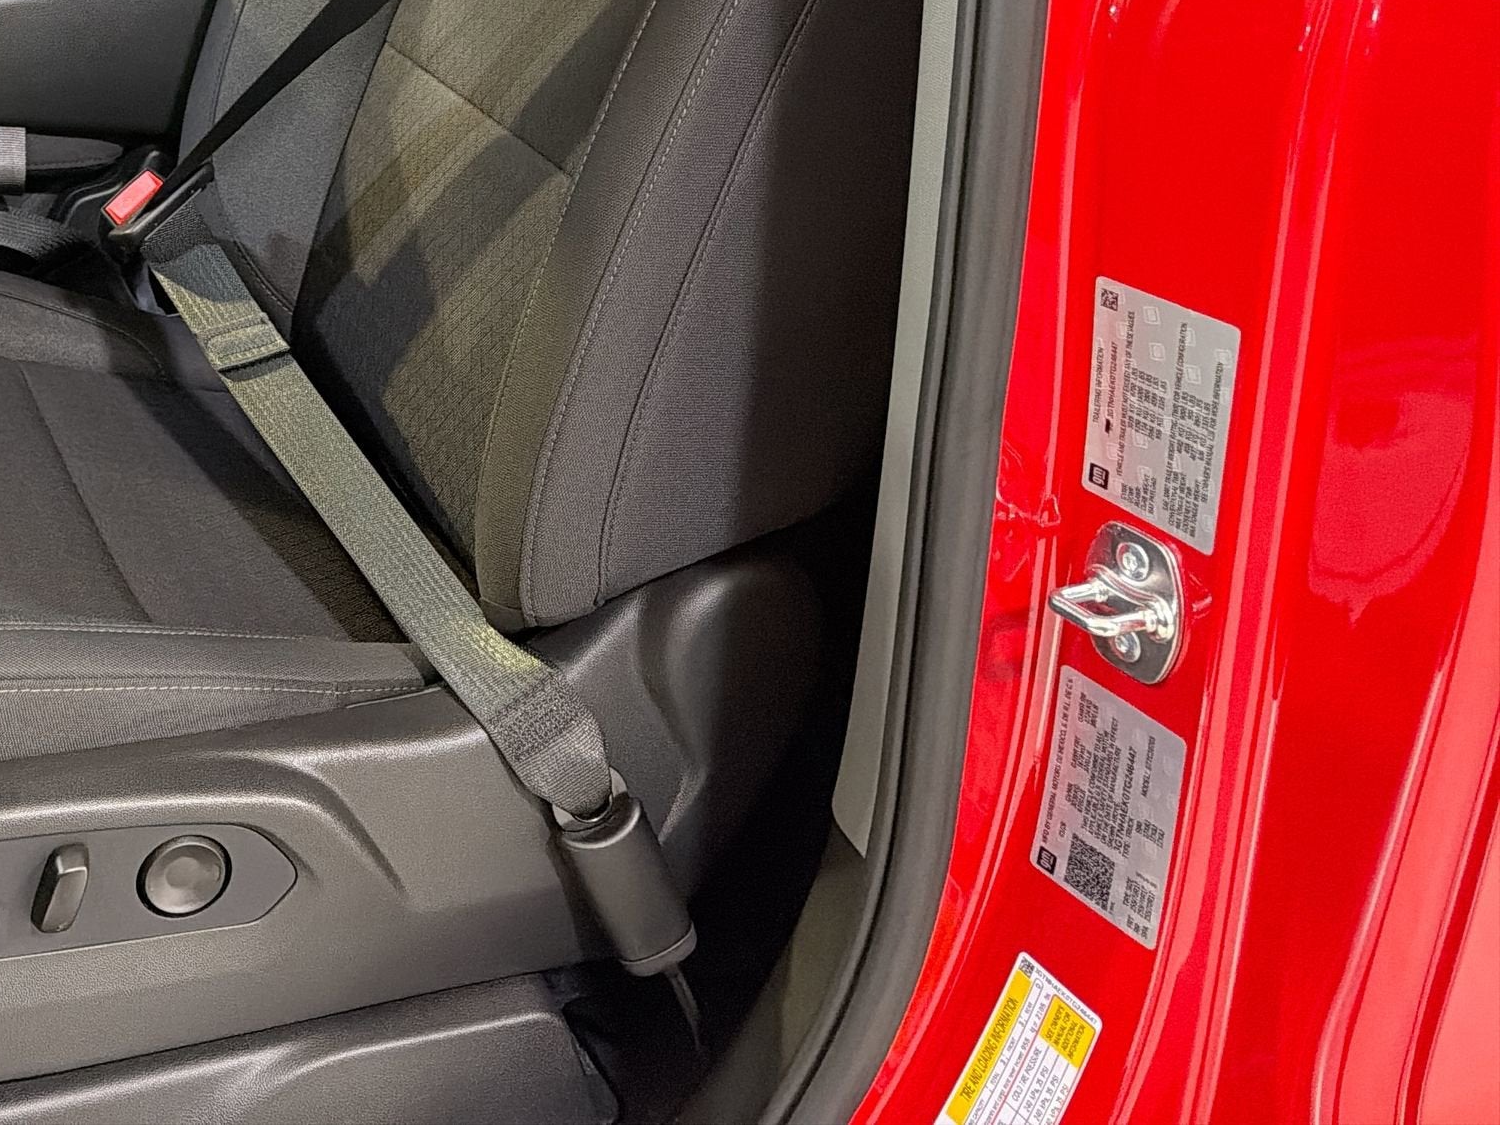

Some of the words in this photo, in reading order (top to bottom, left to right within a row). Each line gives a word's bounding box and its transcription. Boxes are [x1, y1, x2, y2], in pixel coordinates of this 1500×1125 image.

[1039, 848, 1054, 872] gm
[990, 995, 1019, 1043] INFORMATION
[975, 1038, 999, 1073] LOADING
[968, 1068, 984, 1087] AND
[960, 1083, 976, 1102] TIRE
